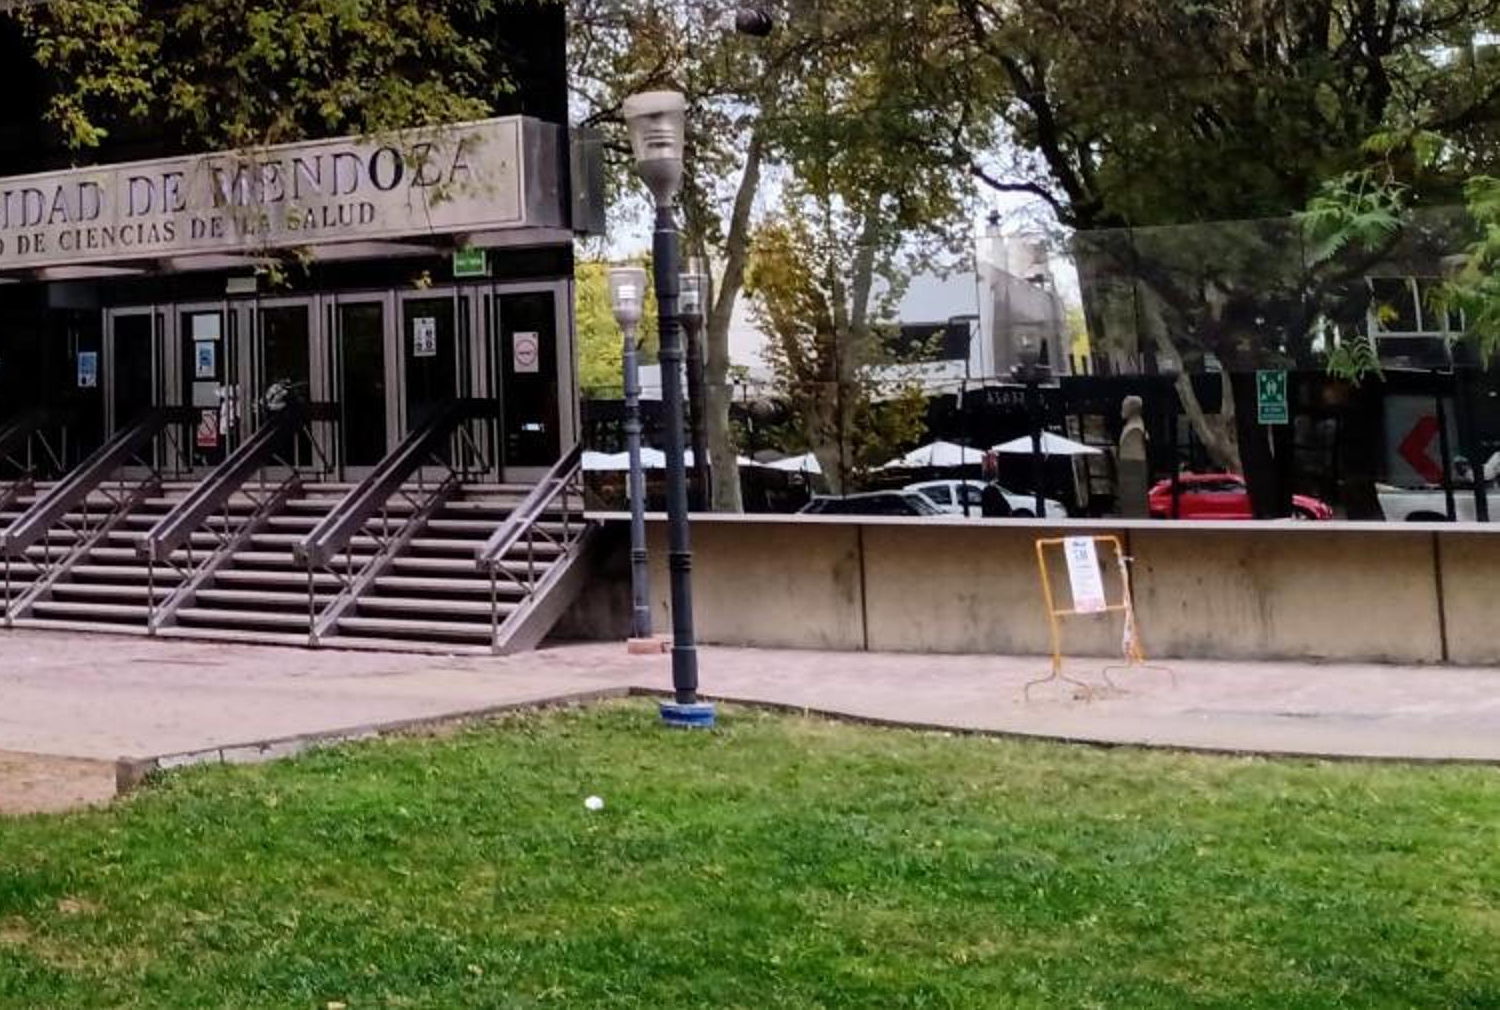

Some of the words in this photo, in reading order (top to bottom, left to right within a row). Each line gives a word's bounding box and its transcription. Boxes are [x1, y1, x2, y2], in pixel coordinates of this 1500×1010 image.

[127, 171, 188, 219] DE
[17, 234, 46, 255] DE
[58, 220, 176, 252] CIENCIAS
[191, 216, 224, 239] DE
[287, 201, 376, 231] SALUD
